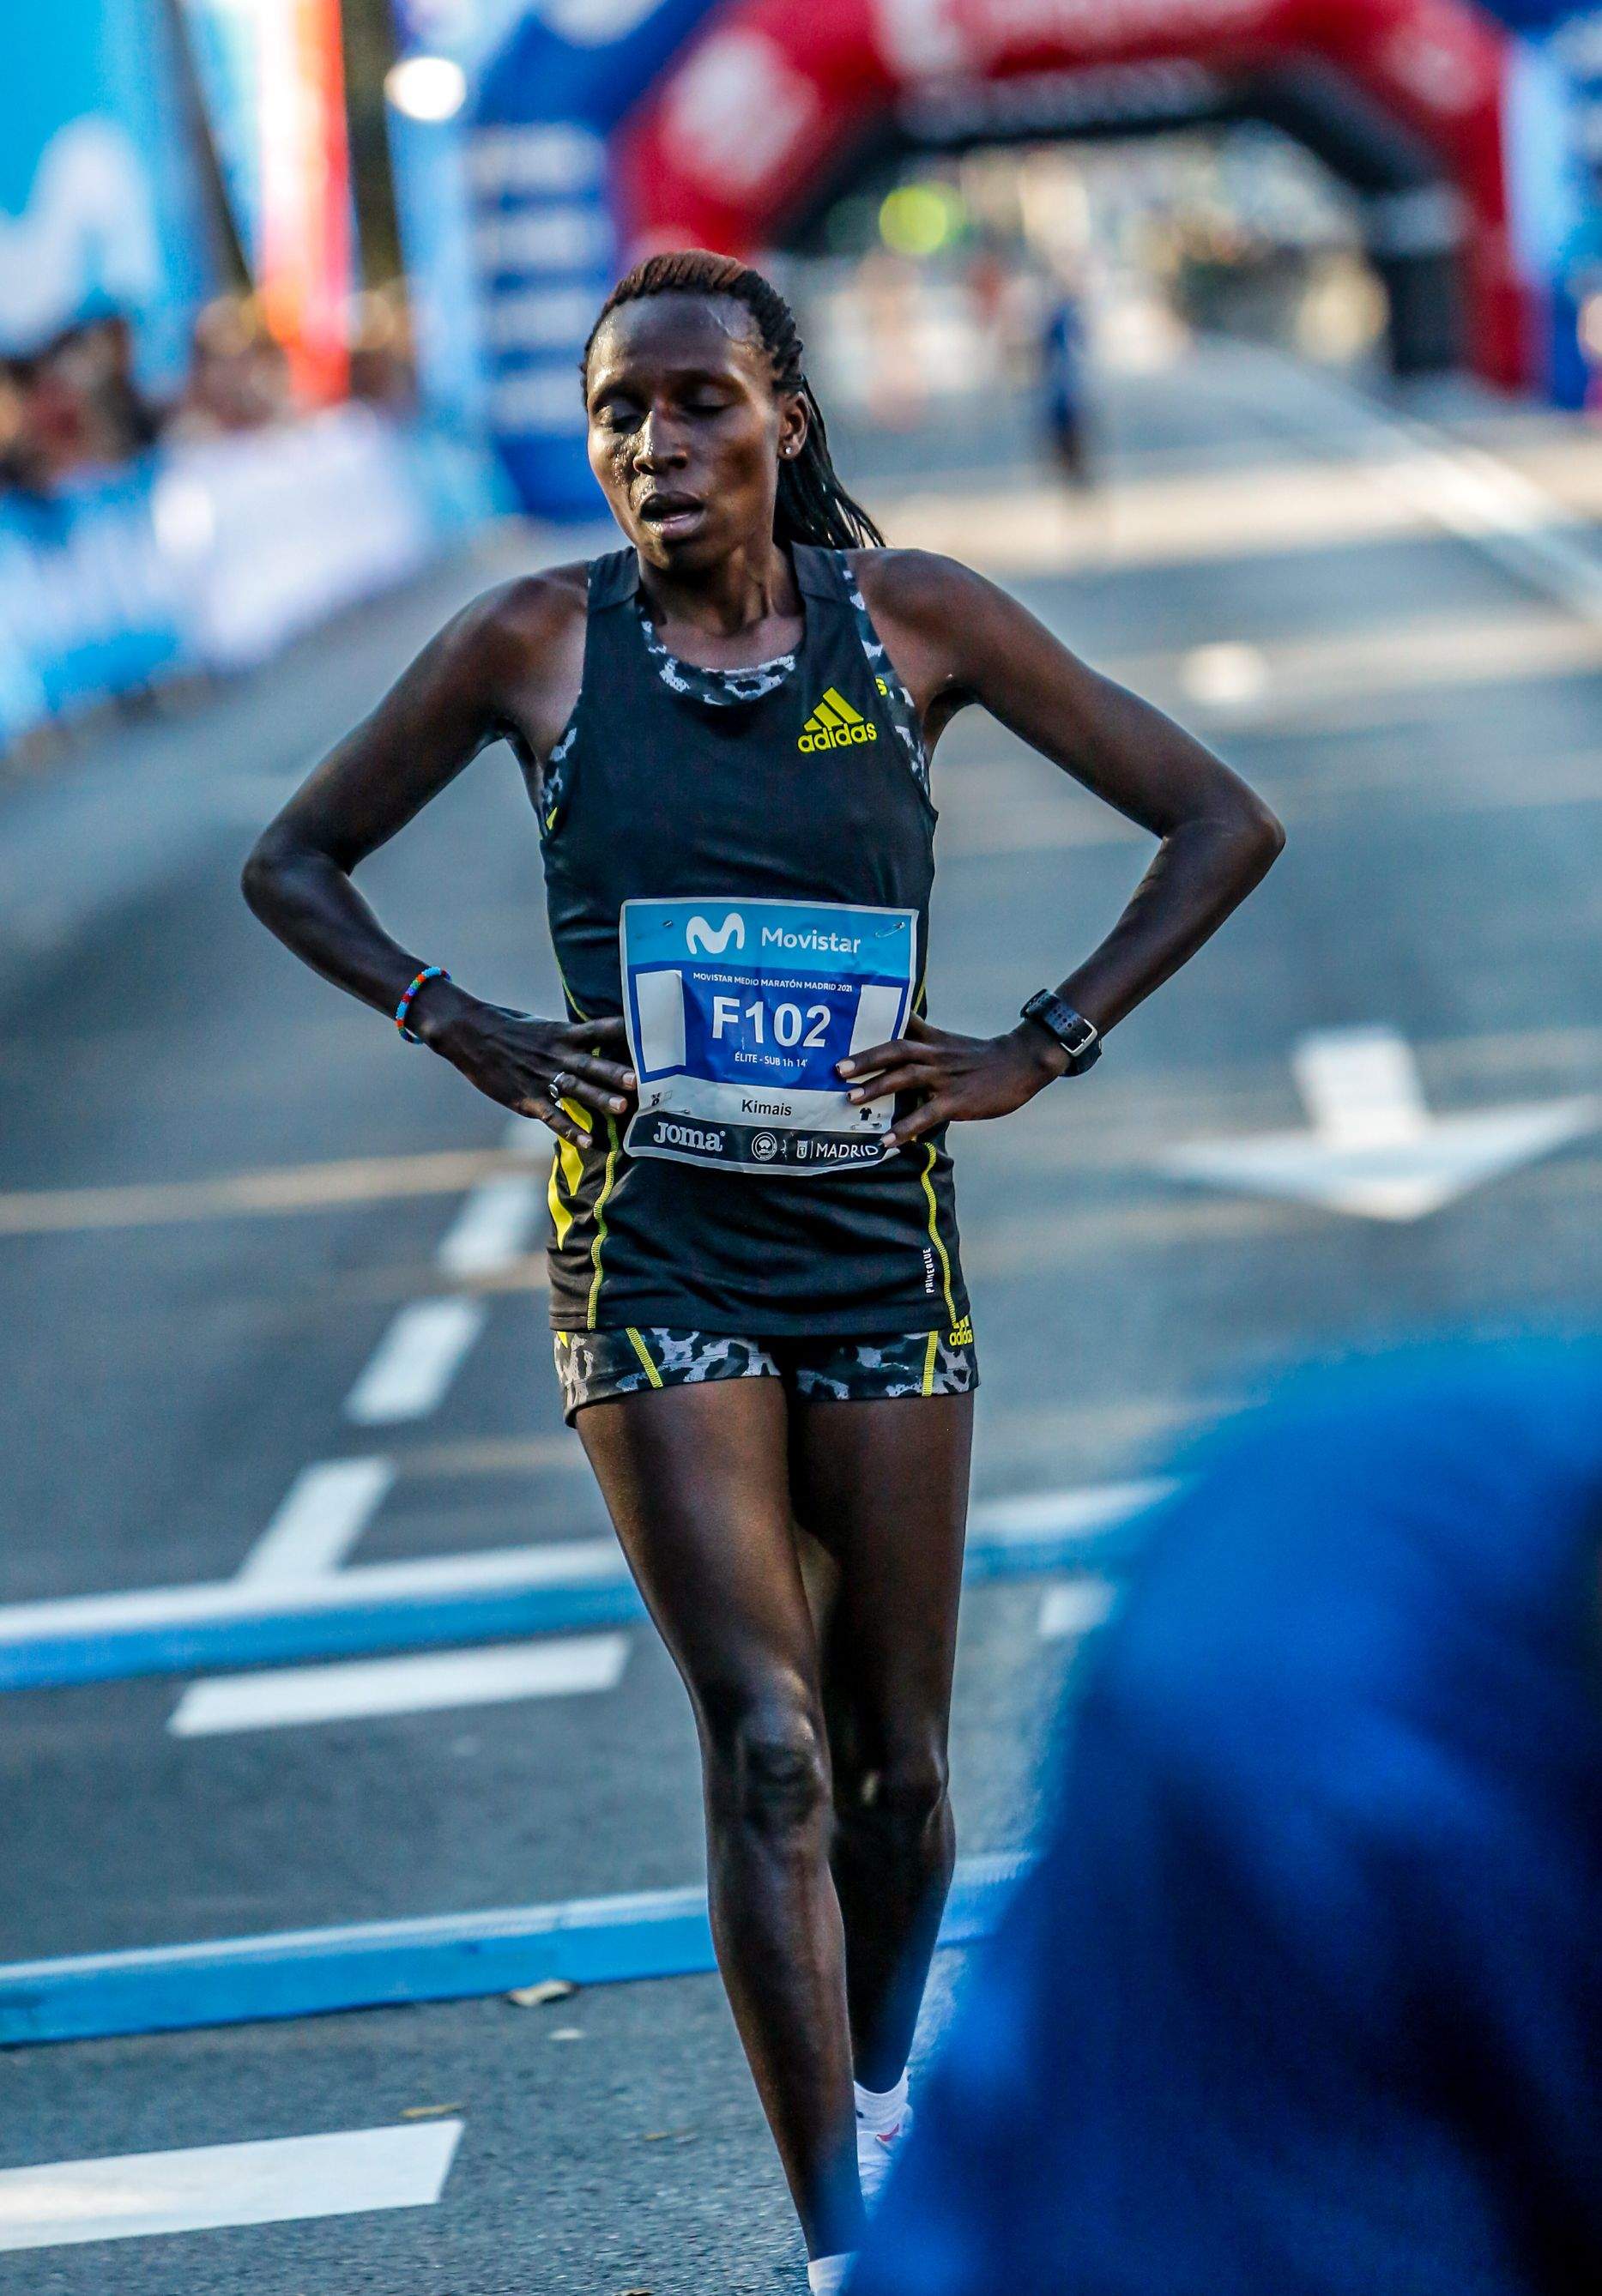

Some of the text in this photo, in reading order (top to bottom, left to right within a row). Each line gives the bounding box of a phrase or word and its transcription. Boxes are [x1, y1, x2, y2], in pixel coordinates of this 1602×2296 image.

[797, 722, 878, 753] adidas
[761, 927, 861, 954] Movistar
[692, 972, 853, 993] MOVISTAR MEDIO MARATÓN MADRID 2021
[712, 995, 831, 1048] F102
[735, 1052, 758, 1063] ÉLITE
[765, 1055, 781, 1066] SUB
[783, 1058, 794, 1067] 1h
[741, 1099, 792, 1116] Kimais
[653, 1121, 723, 1152] Joma
[815, 1143, 879, 1158] MADRID
[923, 1248, 934, 1294] PRIMEBLUE
